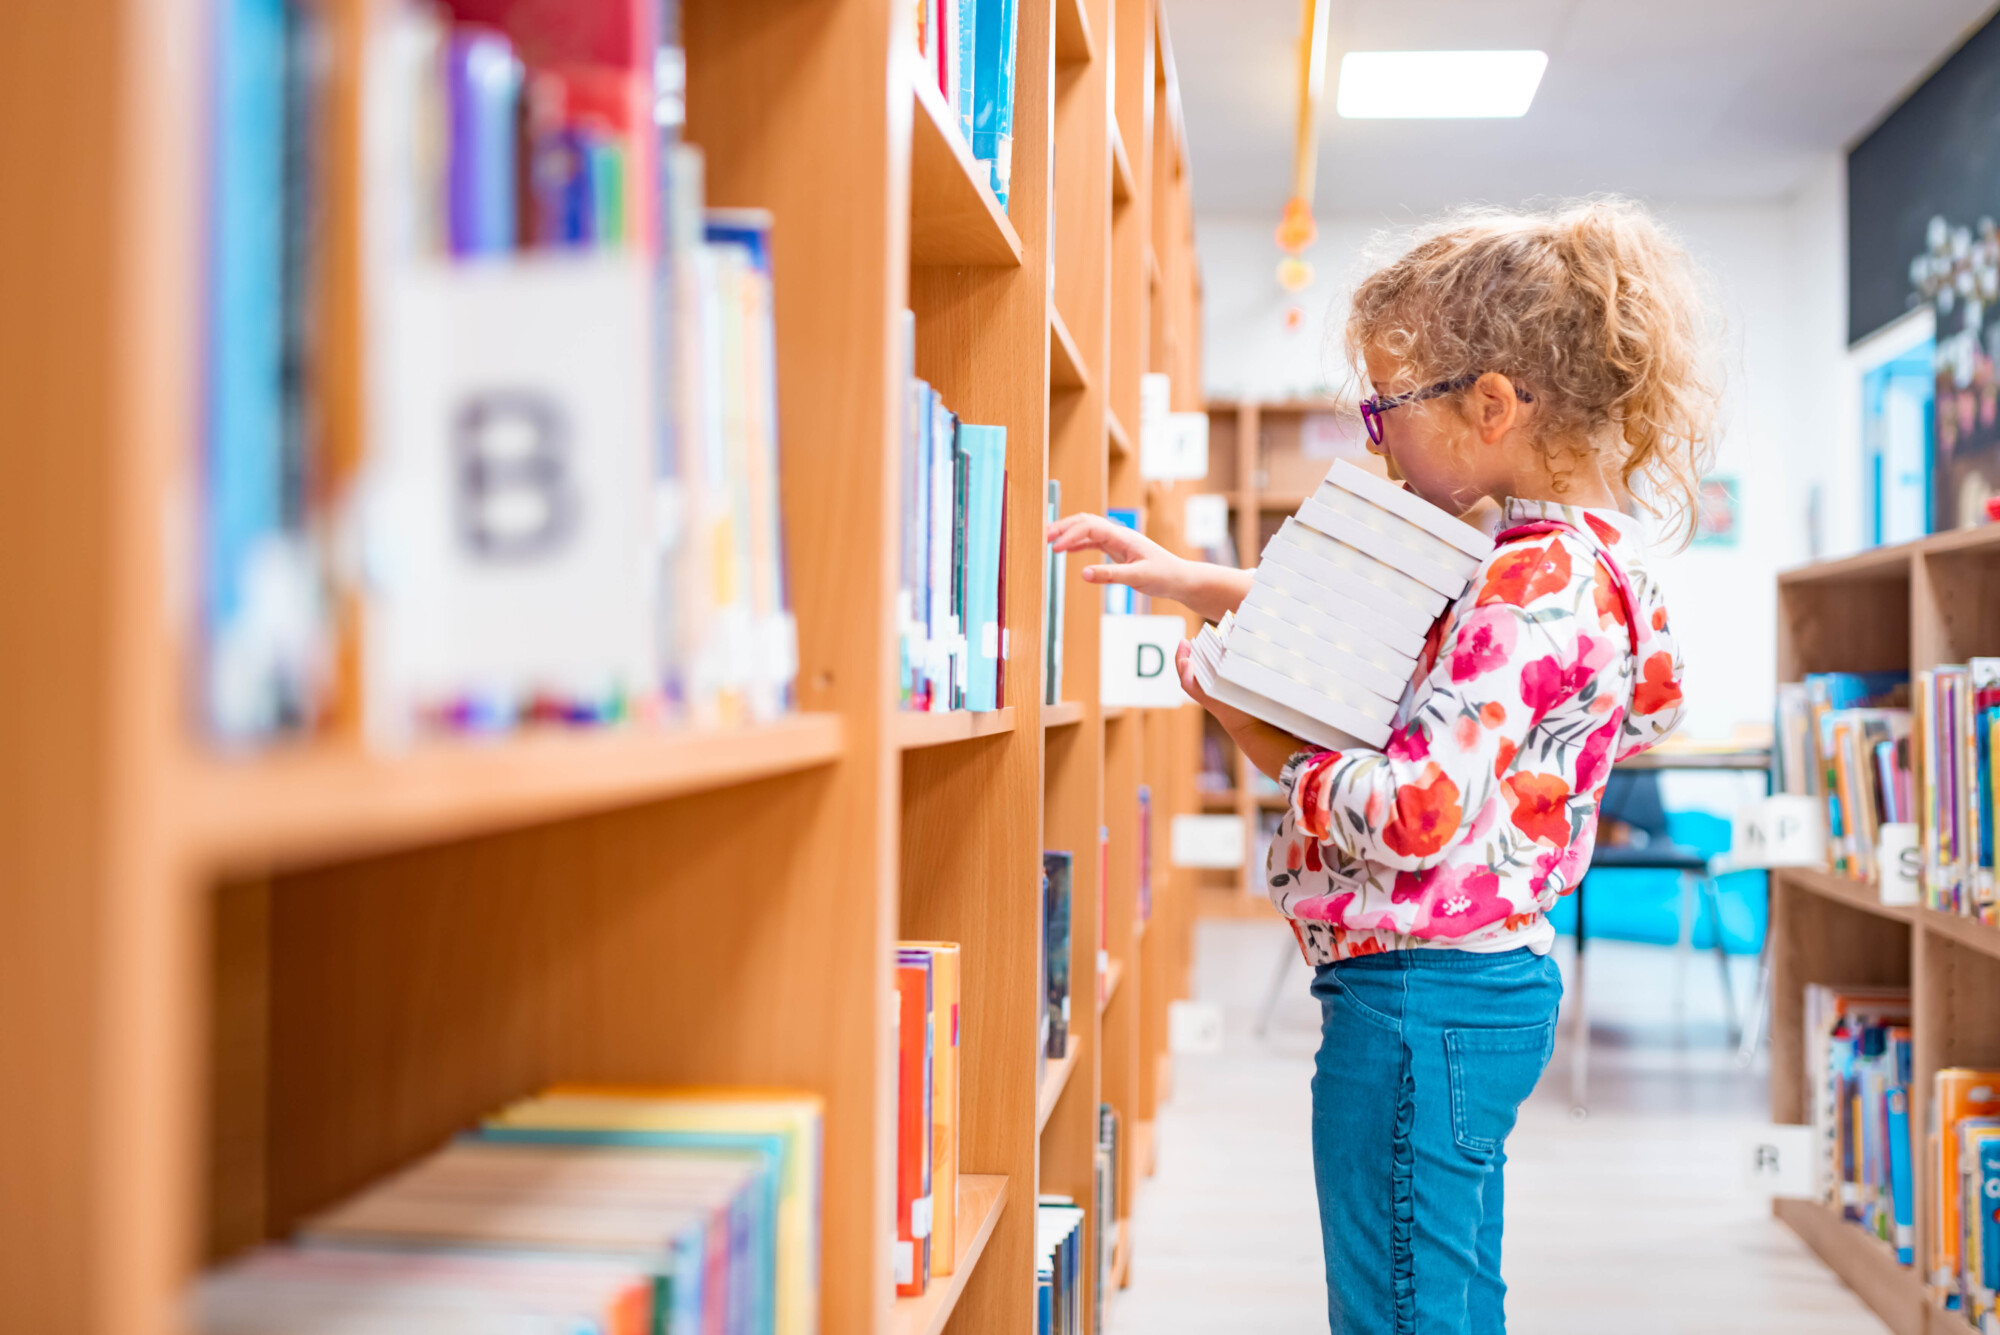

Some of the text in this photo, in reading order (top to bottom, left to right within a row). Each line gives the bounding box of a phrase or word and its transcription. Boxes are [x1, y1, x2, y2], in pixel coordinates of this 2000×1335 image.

[447, 388, 583, 563] B
[1137, 644, 1165, 678] D
[1899, 847, 1922, 881] S
[1753, 1144, 1780, 1176] R
